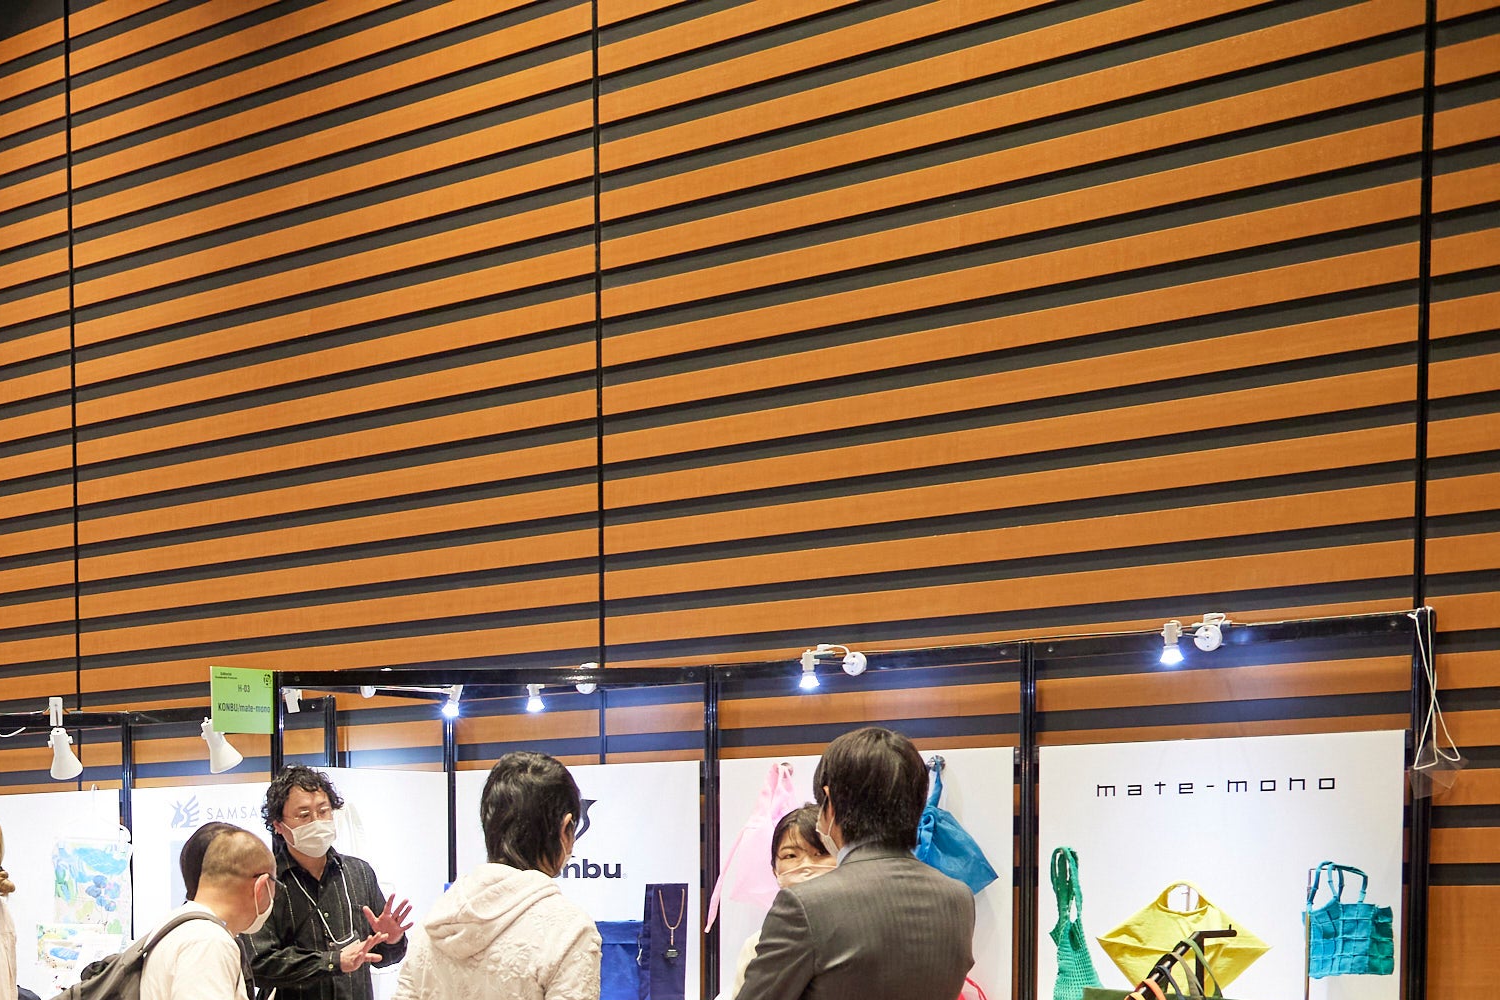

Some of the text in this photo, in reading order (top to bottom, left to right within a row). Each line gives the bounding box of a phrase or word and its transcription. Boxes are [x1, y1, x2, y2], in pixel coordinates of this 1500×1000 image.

[1096, 776, 1336, 797] mate-mono
[206, 805, 262, 820] SAMSA
[555, 858, 622, 879] nbu
